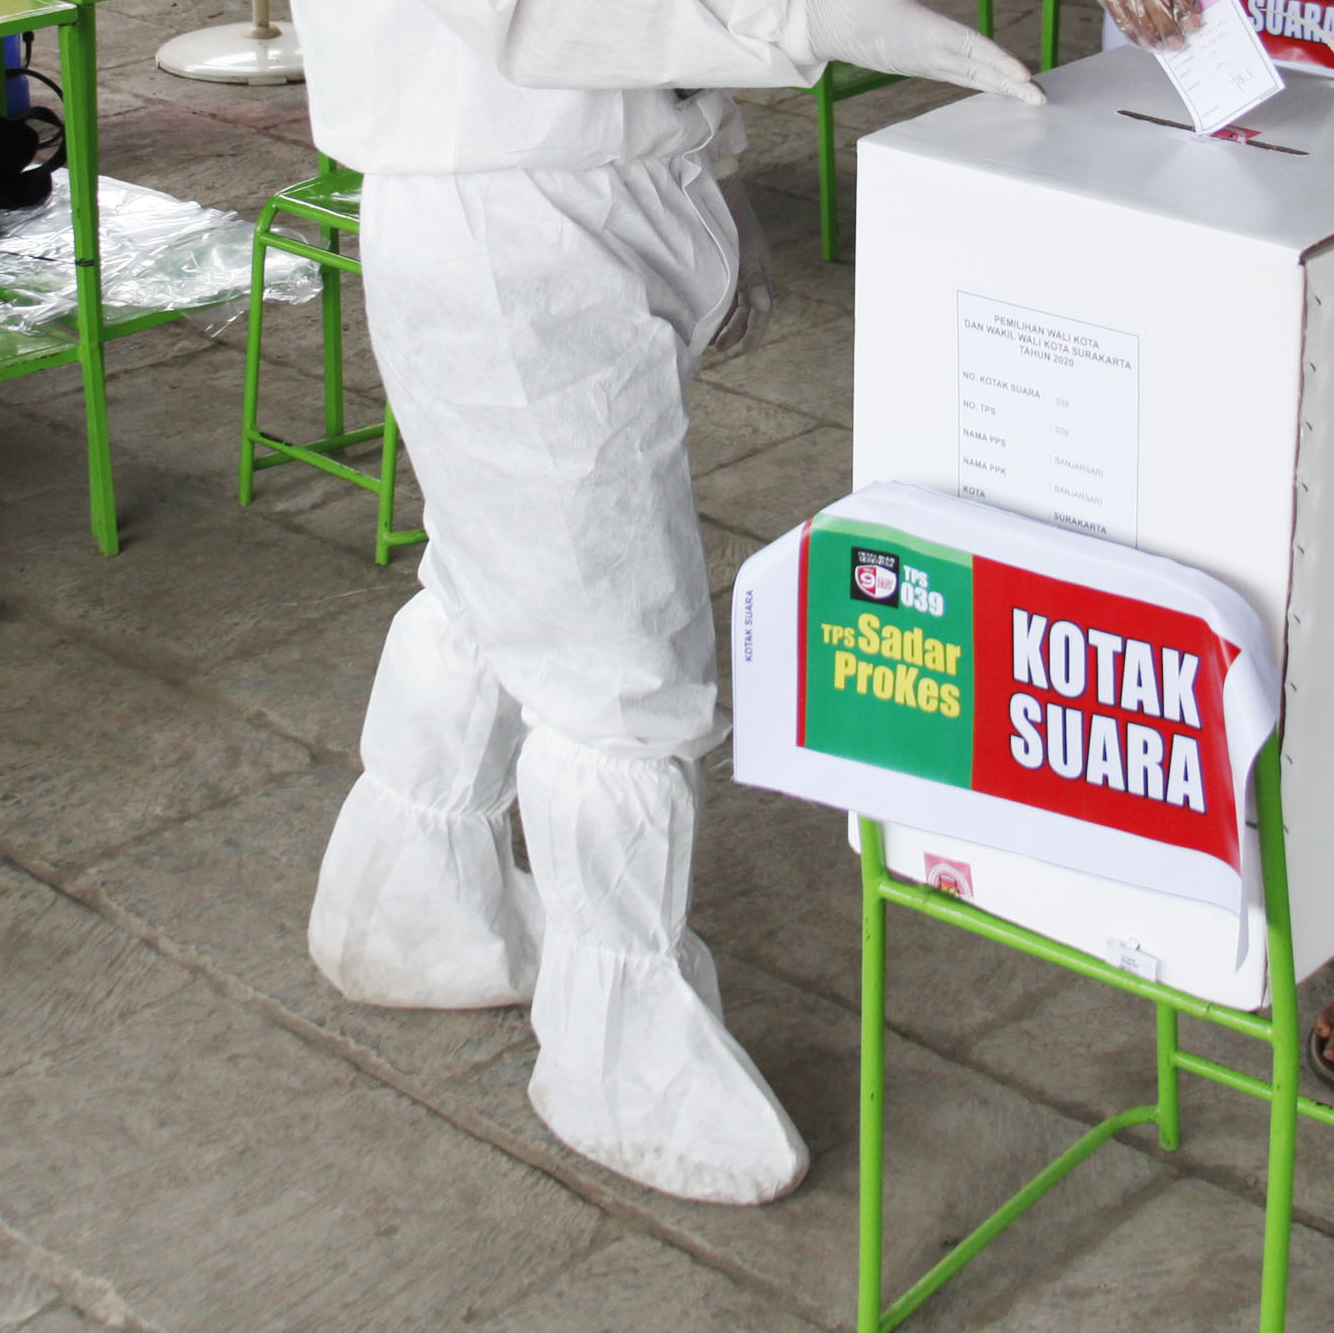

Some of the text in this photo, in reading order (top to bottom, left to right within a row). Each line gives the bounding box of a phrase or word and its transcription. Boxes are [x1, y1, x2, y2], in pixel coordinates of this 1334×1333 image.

[964, 318, 1133, 370] DAN WAKIL WALI KOTA SURAKARTA
[993, 314, 1100, 350] PEMILIHAN WALI KOTA
[1018, 344, 1075, 368] TAHUN 2020
[962, 370, 1041, 399] NO. KOTAK SUARA
[962, 399, 996, 416] NO. TPS
[962, 427, 1006, 447] NAMA PPS
[962, 456, 1007, 476] NAMA PPK
[1054, 456, 1104, 479] BANJARSARI
[962, 484, 986, 499] KOTA
[1053, 512, 1107, 534] SURAKARTA
[903, 565, 929, 588] TPS
[900, 582, 945, 617] 039
[744, 589, 754, 662] KOTAK SUARA
[821, 612, 962, 676] TPS Sadar
[1012, 607, 1202, 729] KOTAK
[833, 650, 962, 719] ProKes
[1008, 692, 1208, 815] SUARA
